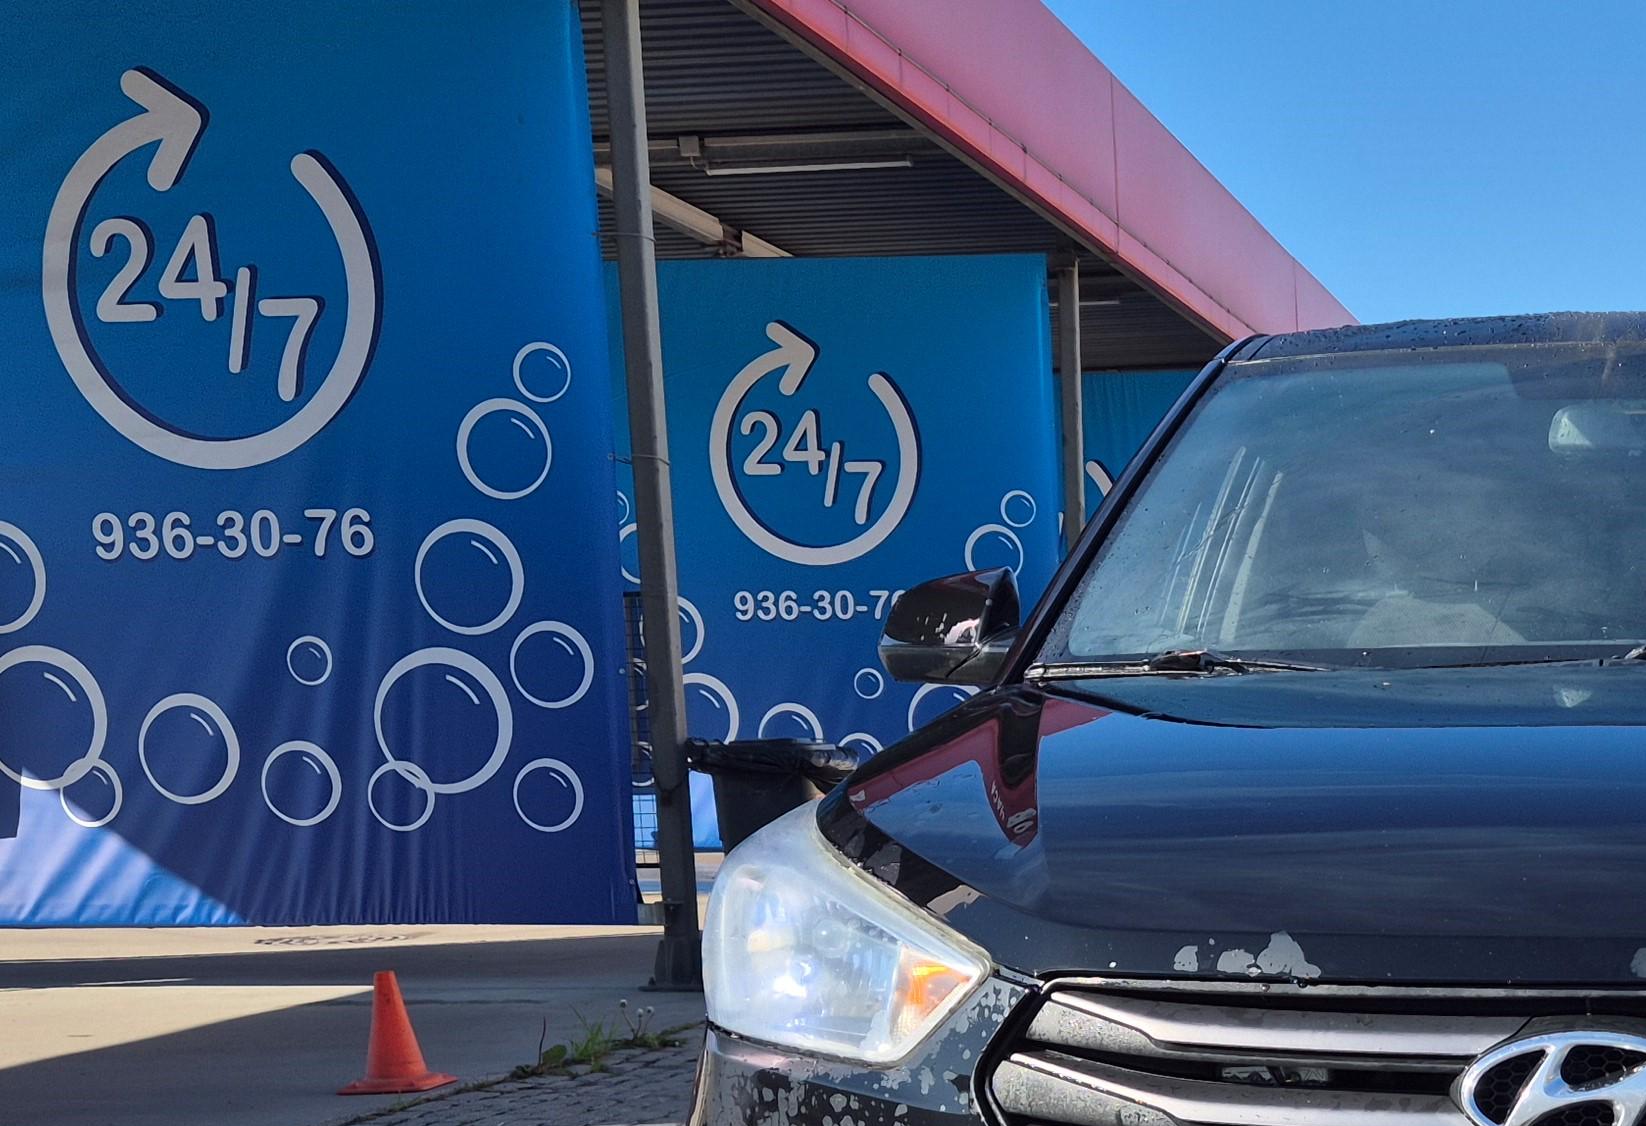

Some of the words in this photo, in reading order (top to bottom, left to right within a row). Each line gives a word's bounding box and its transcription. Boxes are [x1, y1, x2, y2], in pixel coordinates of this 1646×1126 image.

[90, 215, 318, 402] 24/7
[740, 410, 883, 524] 24/7
[92, 508, 375, 560] 936-30-76
